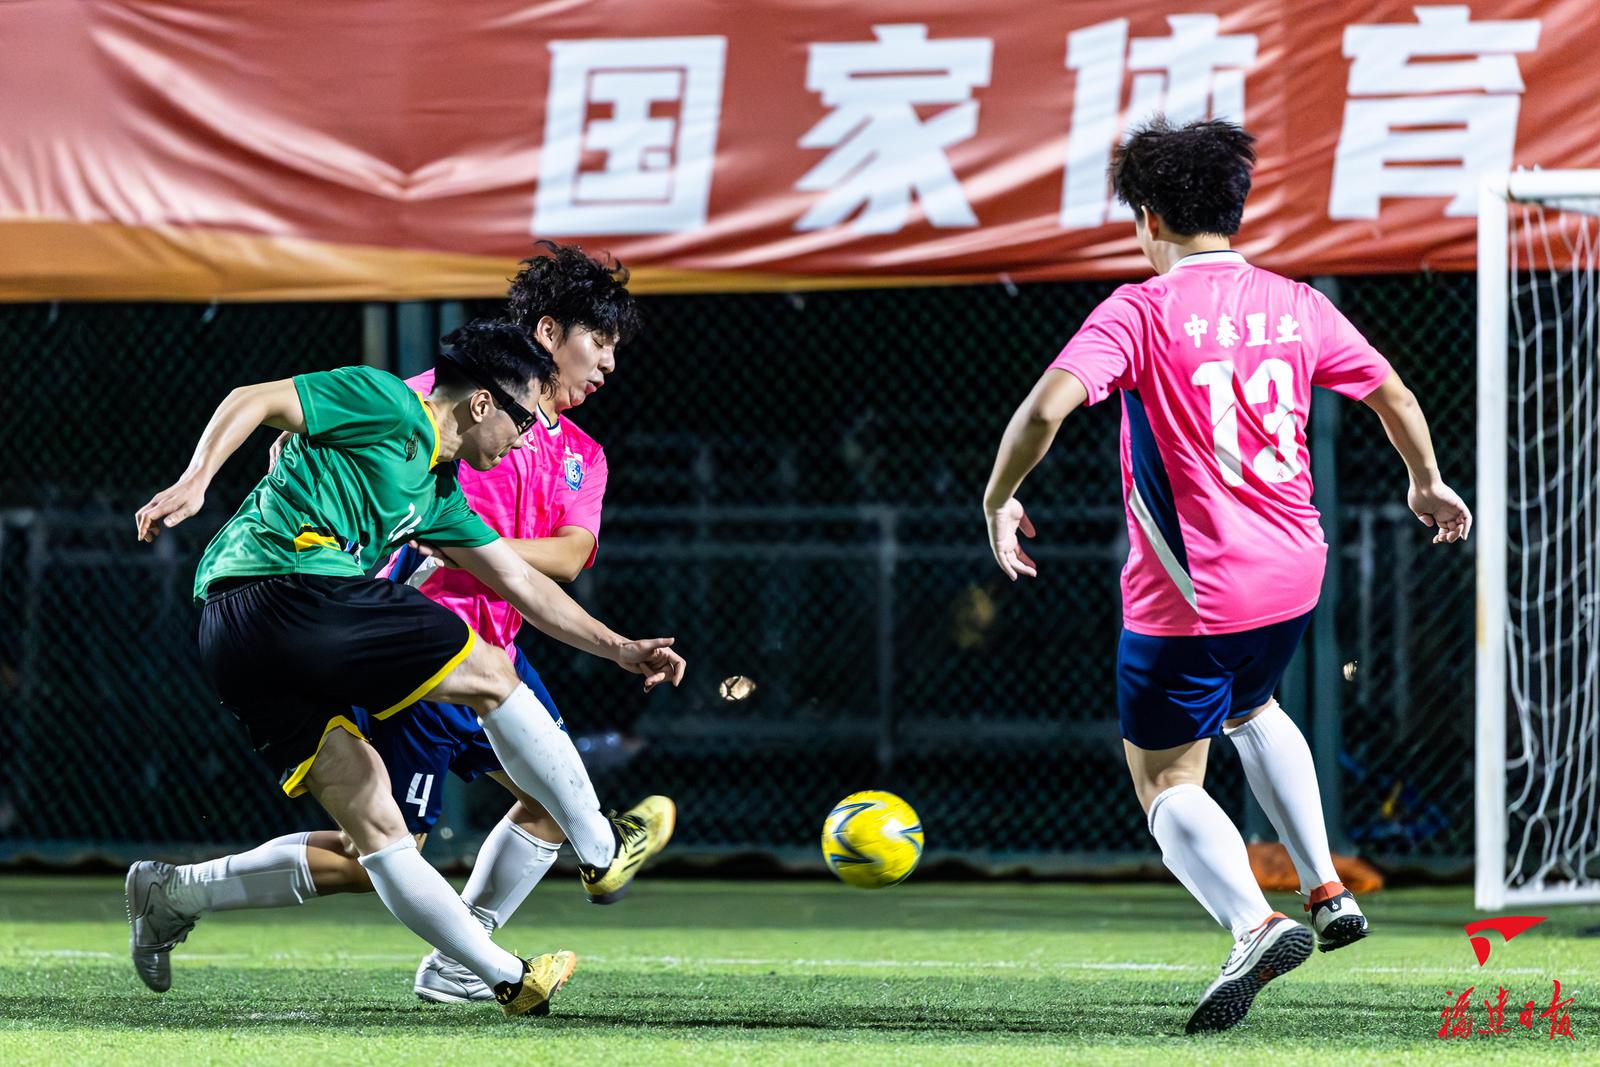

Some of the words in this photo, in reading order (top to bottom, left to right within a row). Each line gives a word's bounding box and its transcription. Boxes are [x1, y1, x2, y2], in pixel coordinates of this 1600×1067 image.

[531, 6, 1541, 235] 国家体育
[1192, 358, 1302, 487] 13
[406, 772, 434, 817] 4
